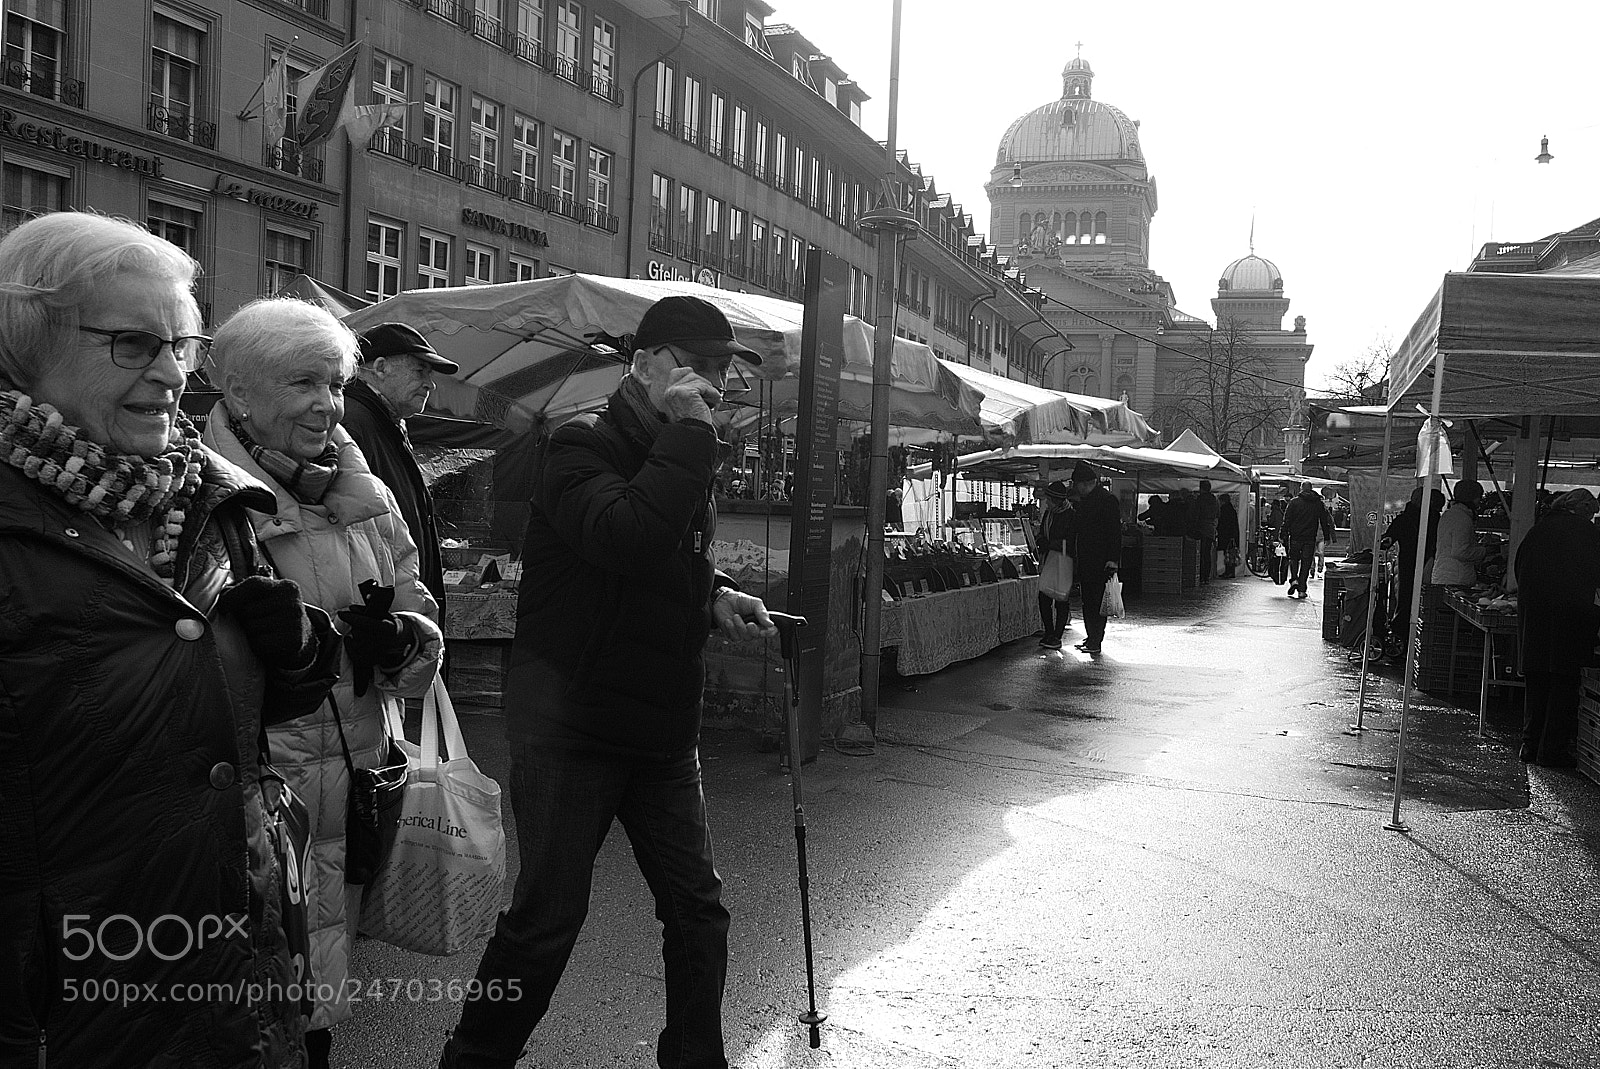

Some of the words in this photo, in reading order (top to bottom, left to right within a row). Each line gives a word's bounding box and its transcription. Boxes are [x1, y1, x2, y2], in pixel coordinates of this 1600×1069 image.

[1, 109, 164, 178] Restaurant
[462, 208, 511, 237] SANTA
[511, 223, 550, 248] LUCIA
[437, 816, 468, 838] Line
